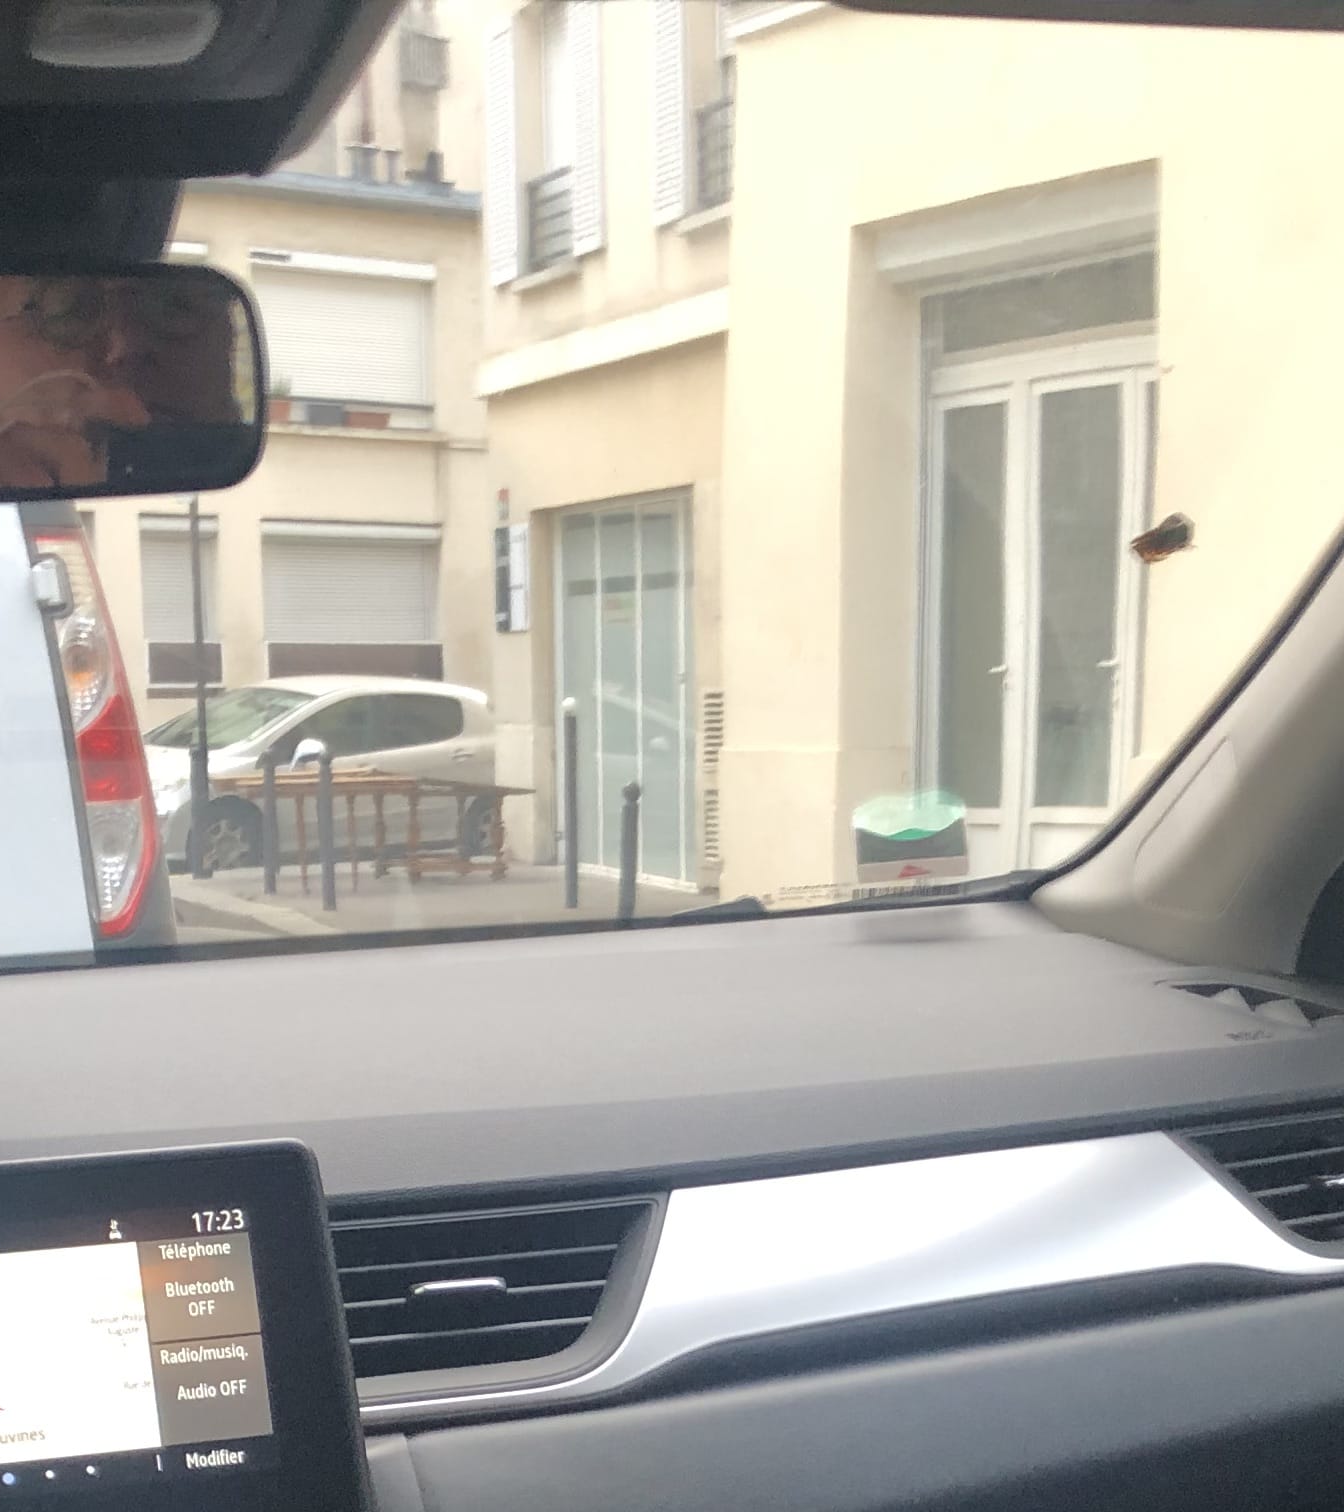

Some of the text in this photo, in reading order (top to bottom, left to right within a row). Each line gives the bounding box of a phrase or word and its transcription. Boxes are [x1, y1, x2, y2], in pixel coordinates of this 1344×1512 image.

[191, 1208, 244, 1232] 17:23
[158, 1242, 231, 1261] Téléphone
[165, 1277, 234, 1297] Bluetooth
[188, 1300, 216, 1316] OFF
[160, 1343, 248, 1364] Radio/musiq.
[177, 1379, 247, 1401] Audio OFF
[186, 1449, 245, 1470] Modifier
